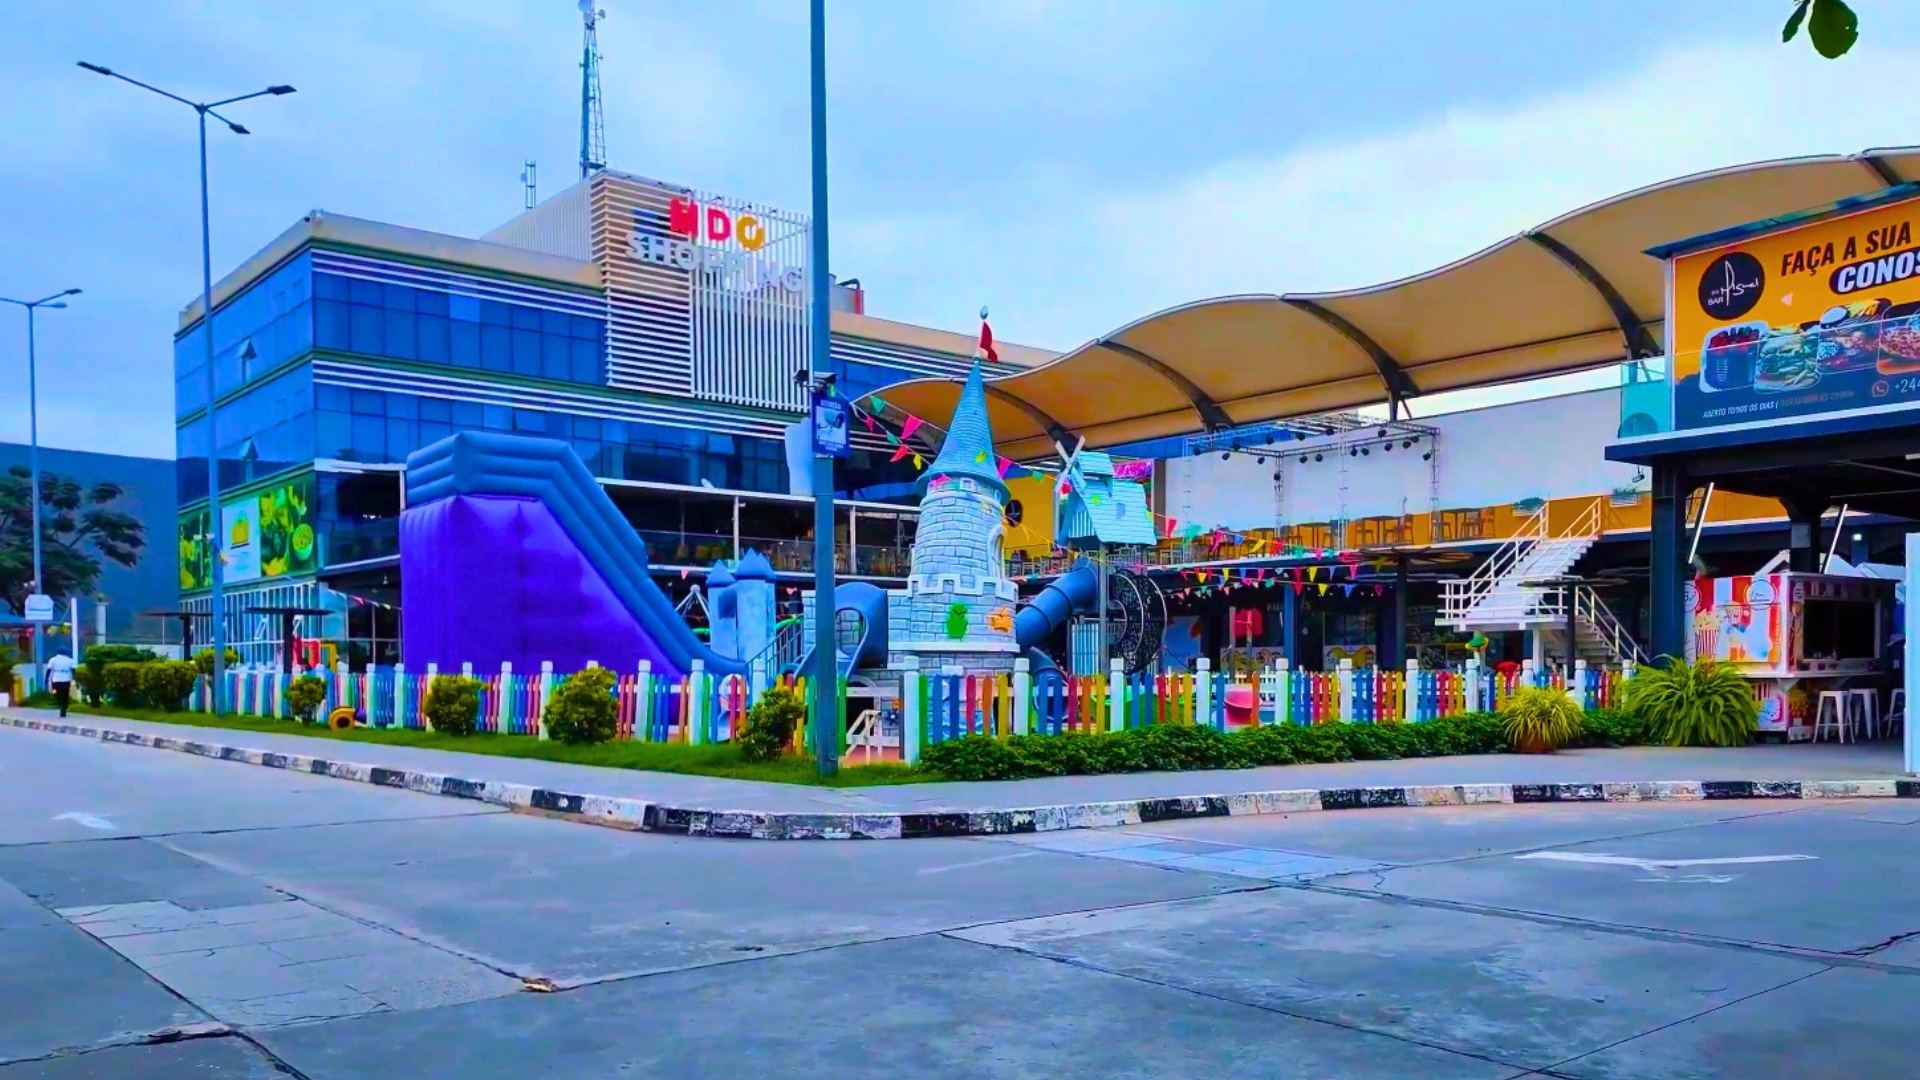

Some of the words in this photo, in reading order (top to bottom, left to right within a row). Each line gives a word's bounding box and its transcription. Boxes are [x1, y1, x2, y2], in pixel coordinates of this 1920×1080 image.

[625, 230, 803, 293] SHOPPING
[1780, 242, 1835, 277] FAÇA
[1842, 236, 1857, 261] A
[1865, 221, 1912, 254] SUA
[1707, 296, 1724, 306] BAR
[1749, 402, 1758, 412] OS
[1759, 401, 1775, 411] DIAS
